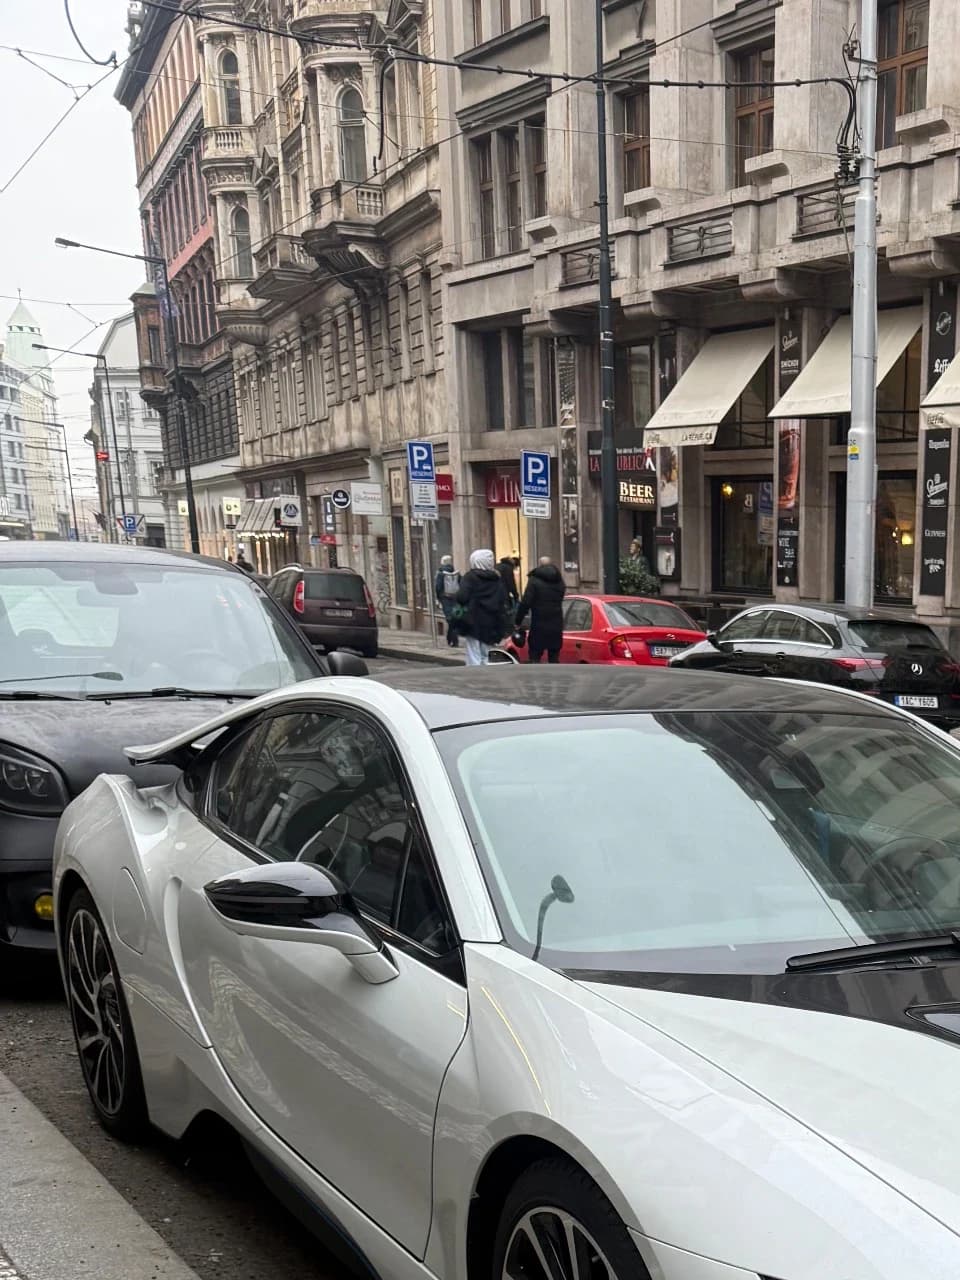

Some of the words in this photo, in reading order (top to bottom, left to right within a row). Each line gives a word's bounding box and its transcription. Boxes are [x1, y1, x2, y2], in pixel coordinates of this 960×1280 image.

[412, 445, 428, 469] P
[527, 457, 545, 483] P
[619, 481, 654, 498] BEER
[619, 496, 655, 505] RESTAURANT
